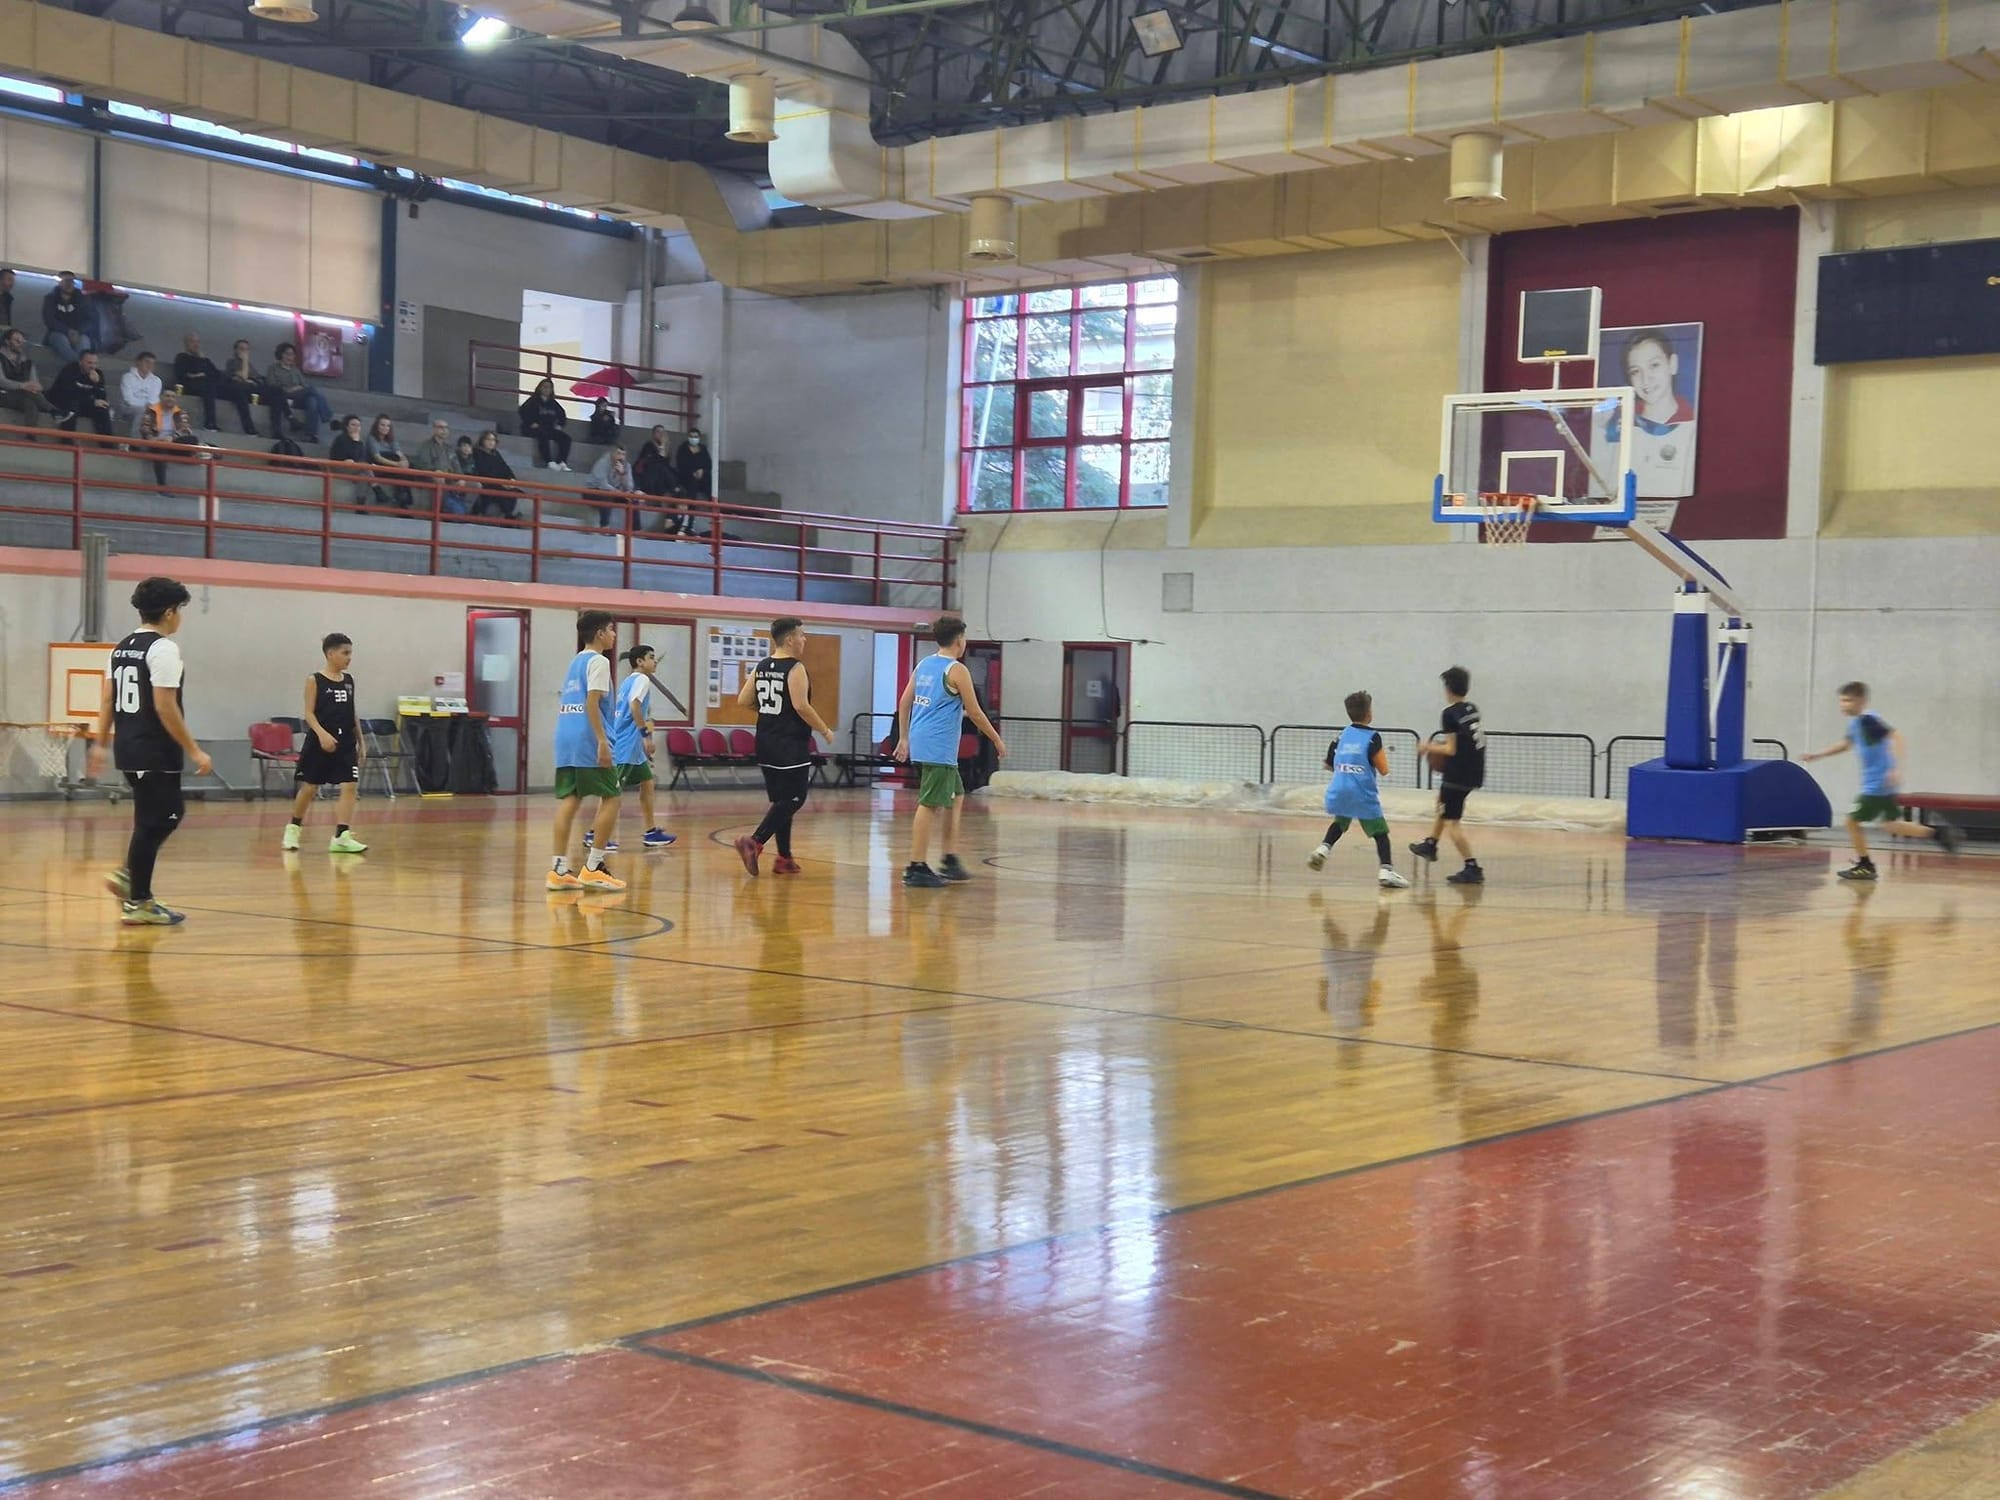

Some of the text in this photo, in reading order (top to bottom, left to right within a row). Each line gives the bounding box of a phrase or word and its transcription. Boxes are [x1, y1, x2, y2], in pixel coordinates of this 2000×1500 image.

[114, 665, 140, 713] 16
[334, 690, 347, 702] 33
[756, 680, 784, 715] 25
